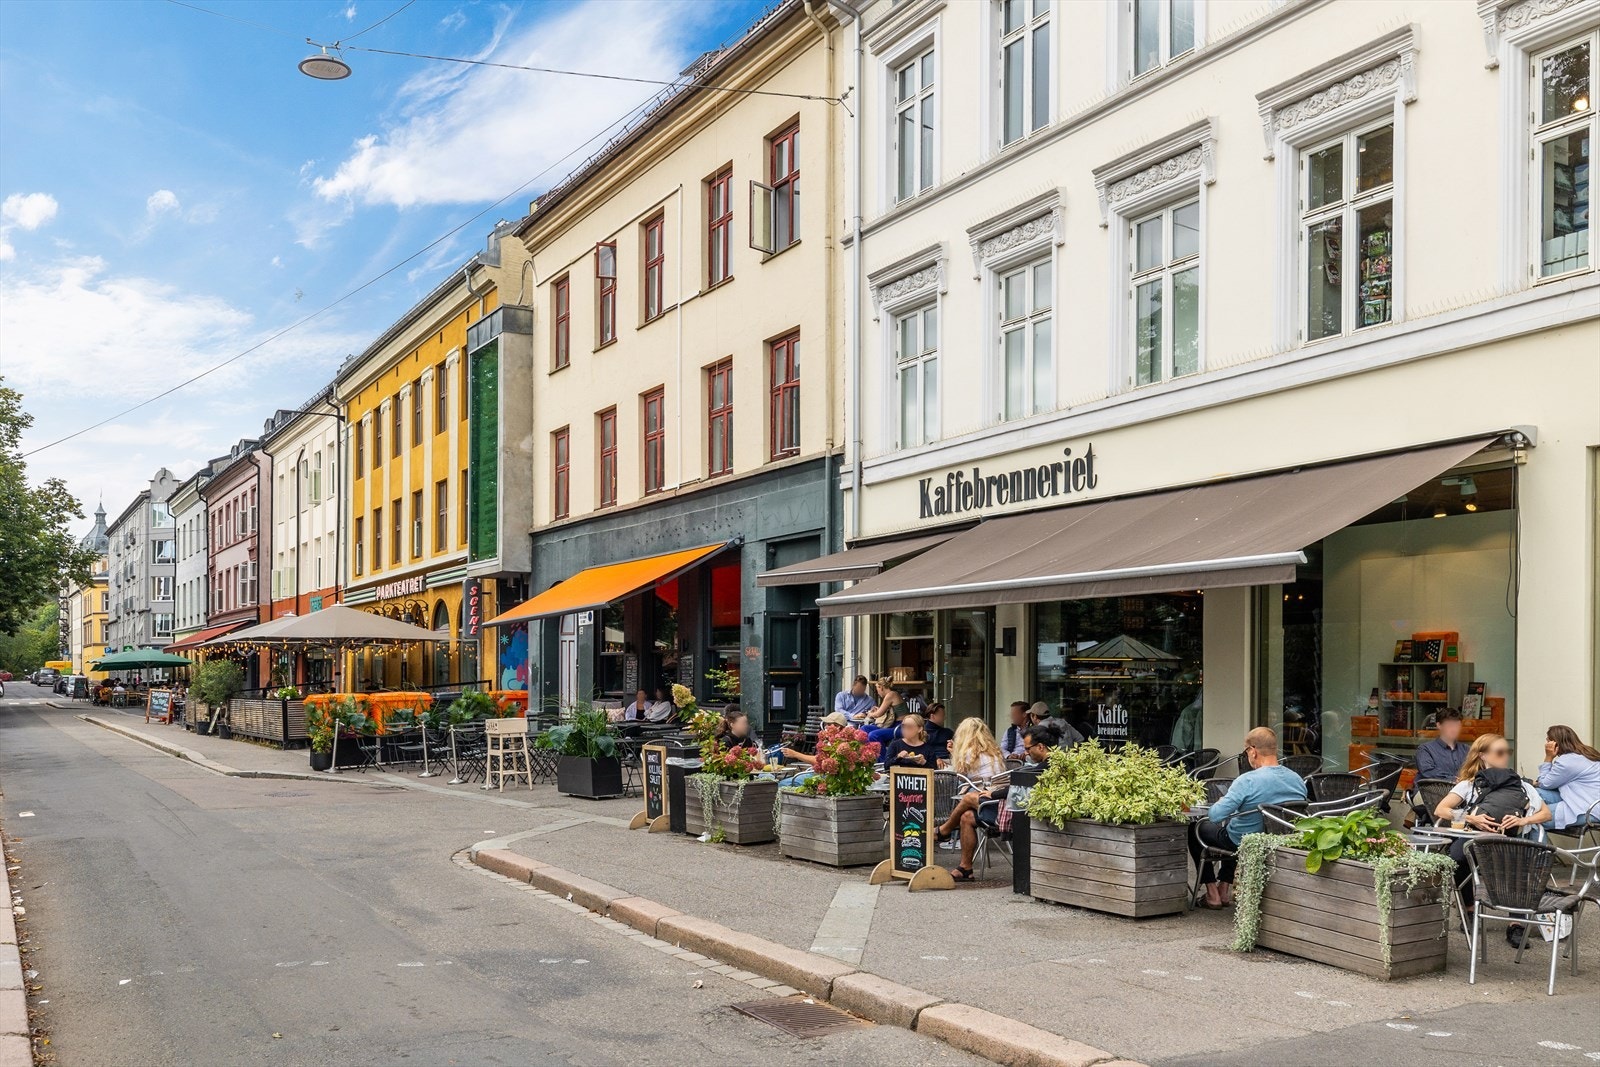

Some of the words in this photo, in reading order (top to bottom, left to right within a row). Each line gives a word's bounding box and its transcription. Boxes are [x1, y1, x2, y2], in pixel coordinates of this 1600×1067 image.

[918, 442, 1098, 519] Kaffebrenneriet
[376, 575, 424, 601] PARKTEATRET
[469, 586, 479, 635] SCENE
[1097, 703, 1129, 725] Kaffe
[1097, 724, 1128, 736] brenneriet
[896, 775, 927, 792] NYHET!
